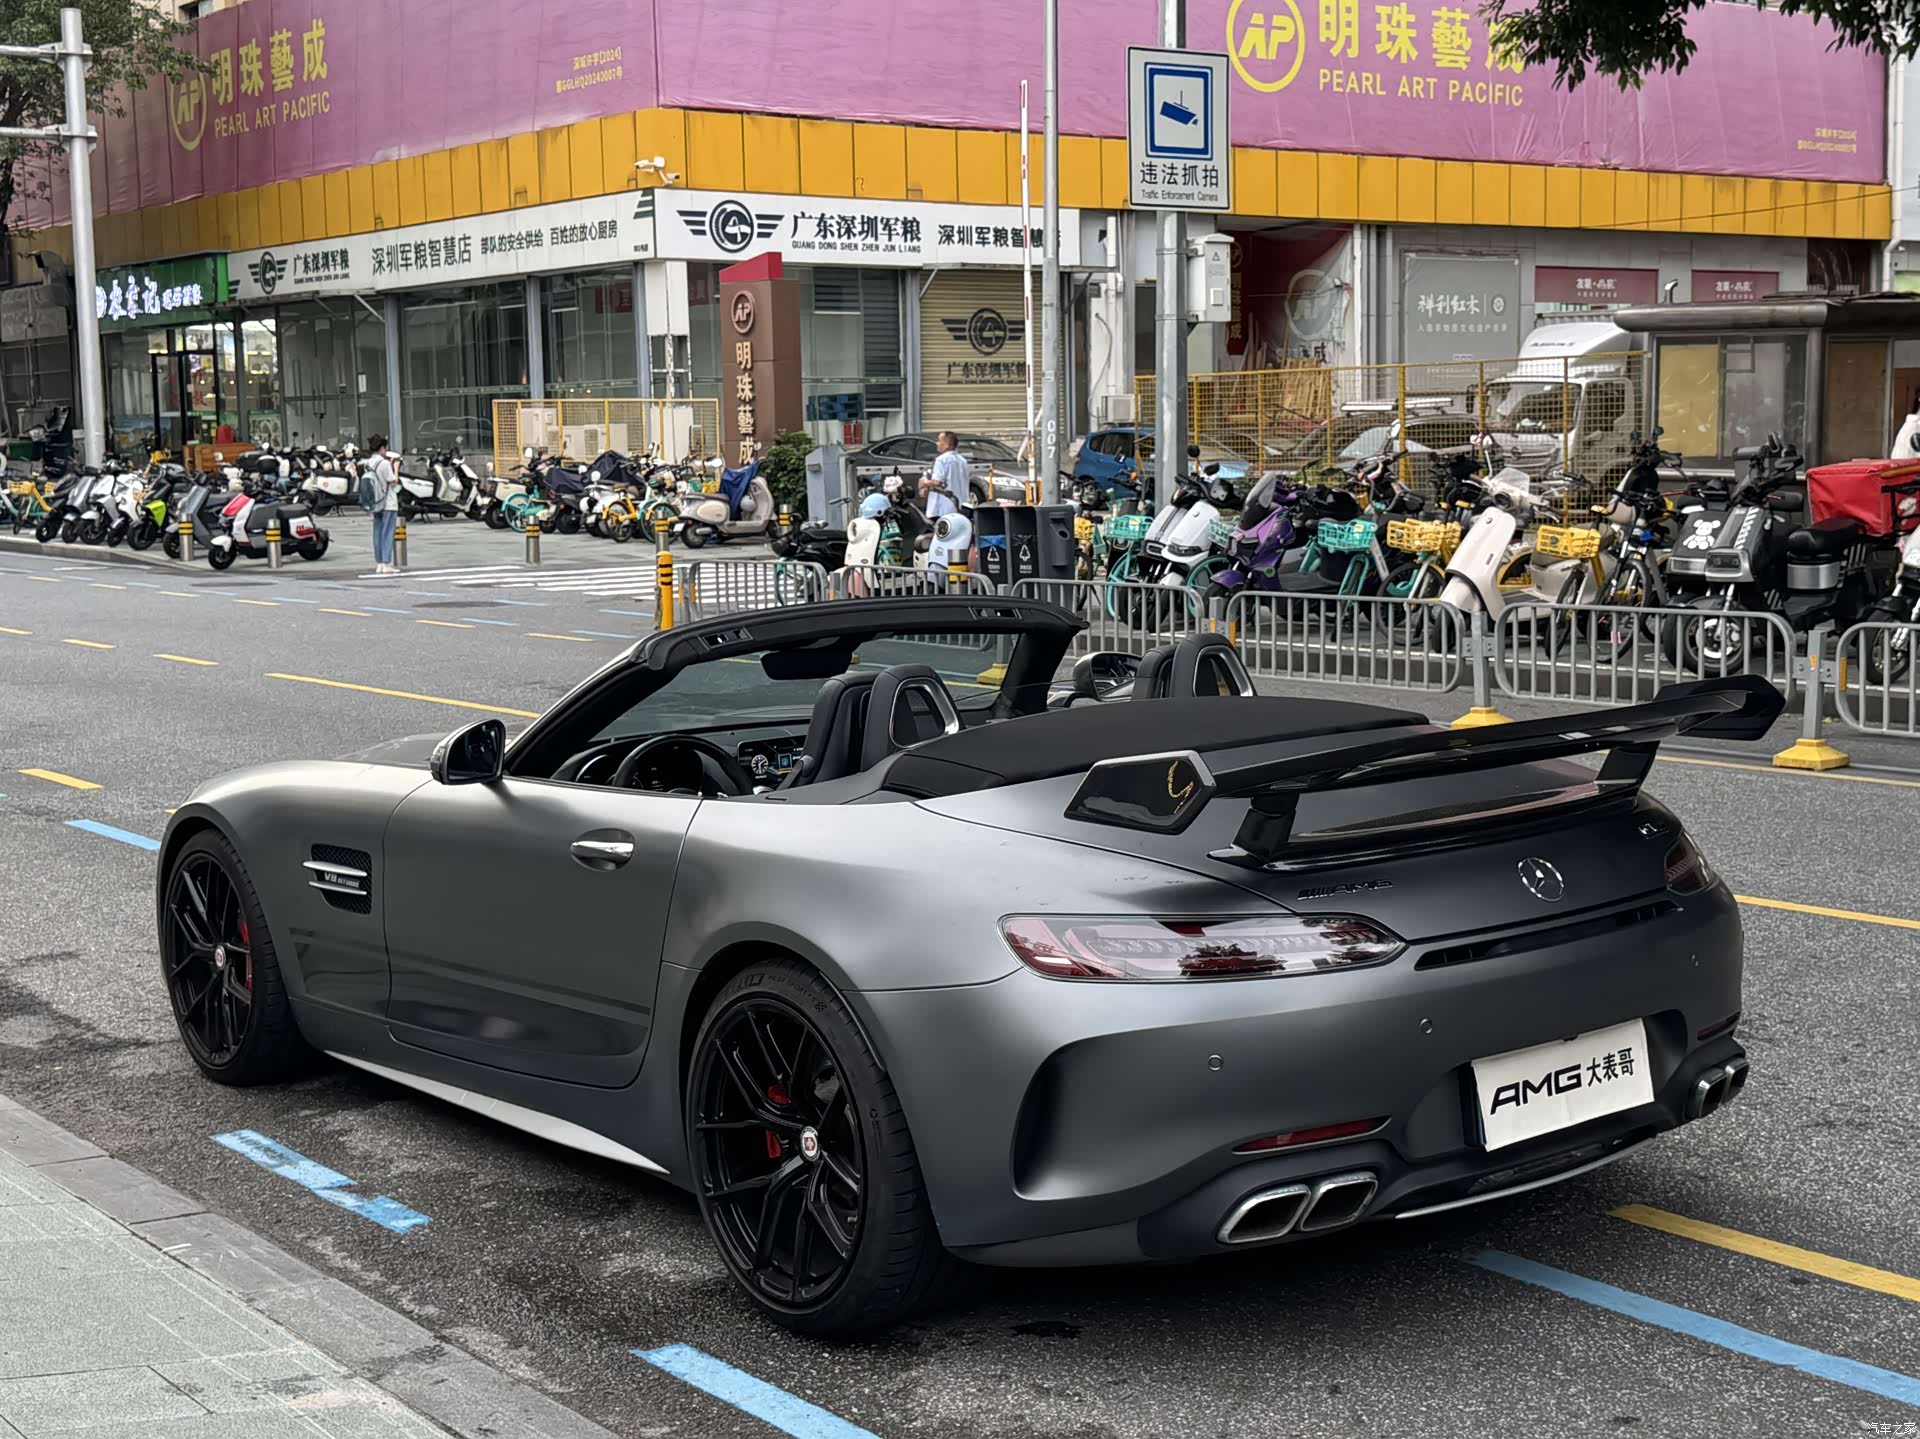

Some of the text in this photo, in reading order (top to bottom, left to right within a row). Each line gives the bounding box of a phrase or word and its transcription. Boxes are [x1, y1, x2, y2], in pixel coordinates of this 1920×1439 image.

[1238, 13, 1296, 60] AP
[210, 18, 328, 106] 明珠藝成
[1319, 68, 1523, 107] PEARL ART PACIFIC
[214, 91, 330, 139] PEARL ART PACIFIC
[1140, 161, 1219, 188] 违法抓拍
[1142, 189, 1219, 202] Traffic Enforcement Camera
[791, 210, 922, 244] 广东深圳军粮
[938, 224, 1061, 249] 深圳军粮智慧
[293, 247, 350, 276] 广东深圳军粮
[371, 219, 618, 276] 深圳军粮智慧店 部队的安全供给 百姓的放心厨房
[792, 240, 921, 253] GUANG DONG SHEN ZHEN JUN LIANG
[1417, 292, 1480, 318] 祥利红木
[736, 341, 755, 465] 明珠藝成
[1490, 1047, 1635, 1115] AMG 大表哥
